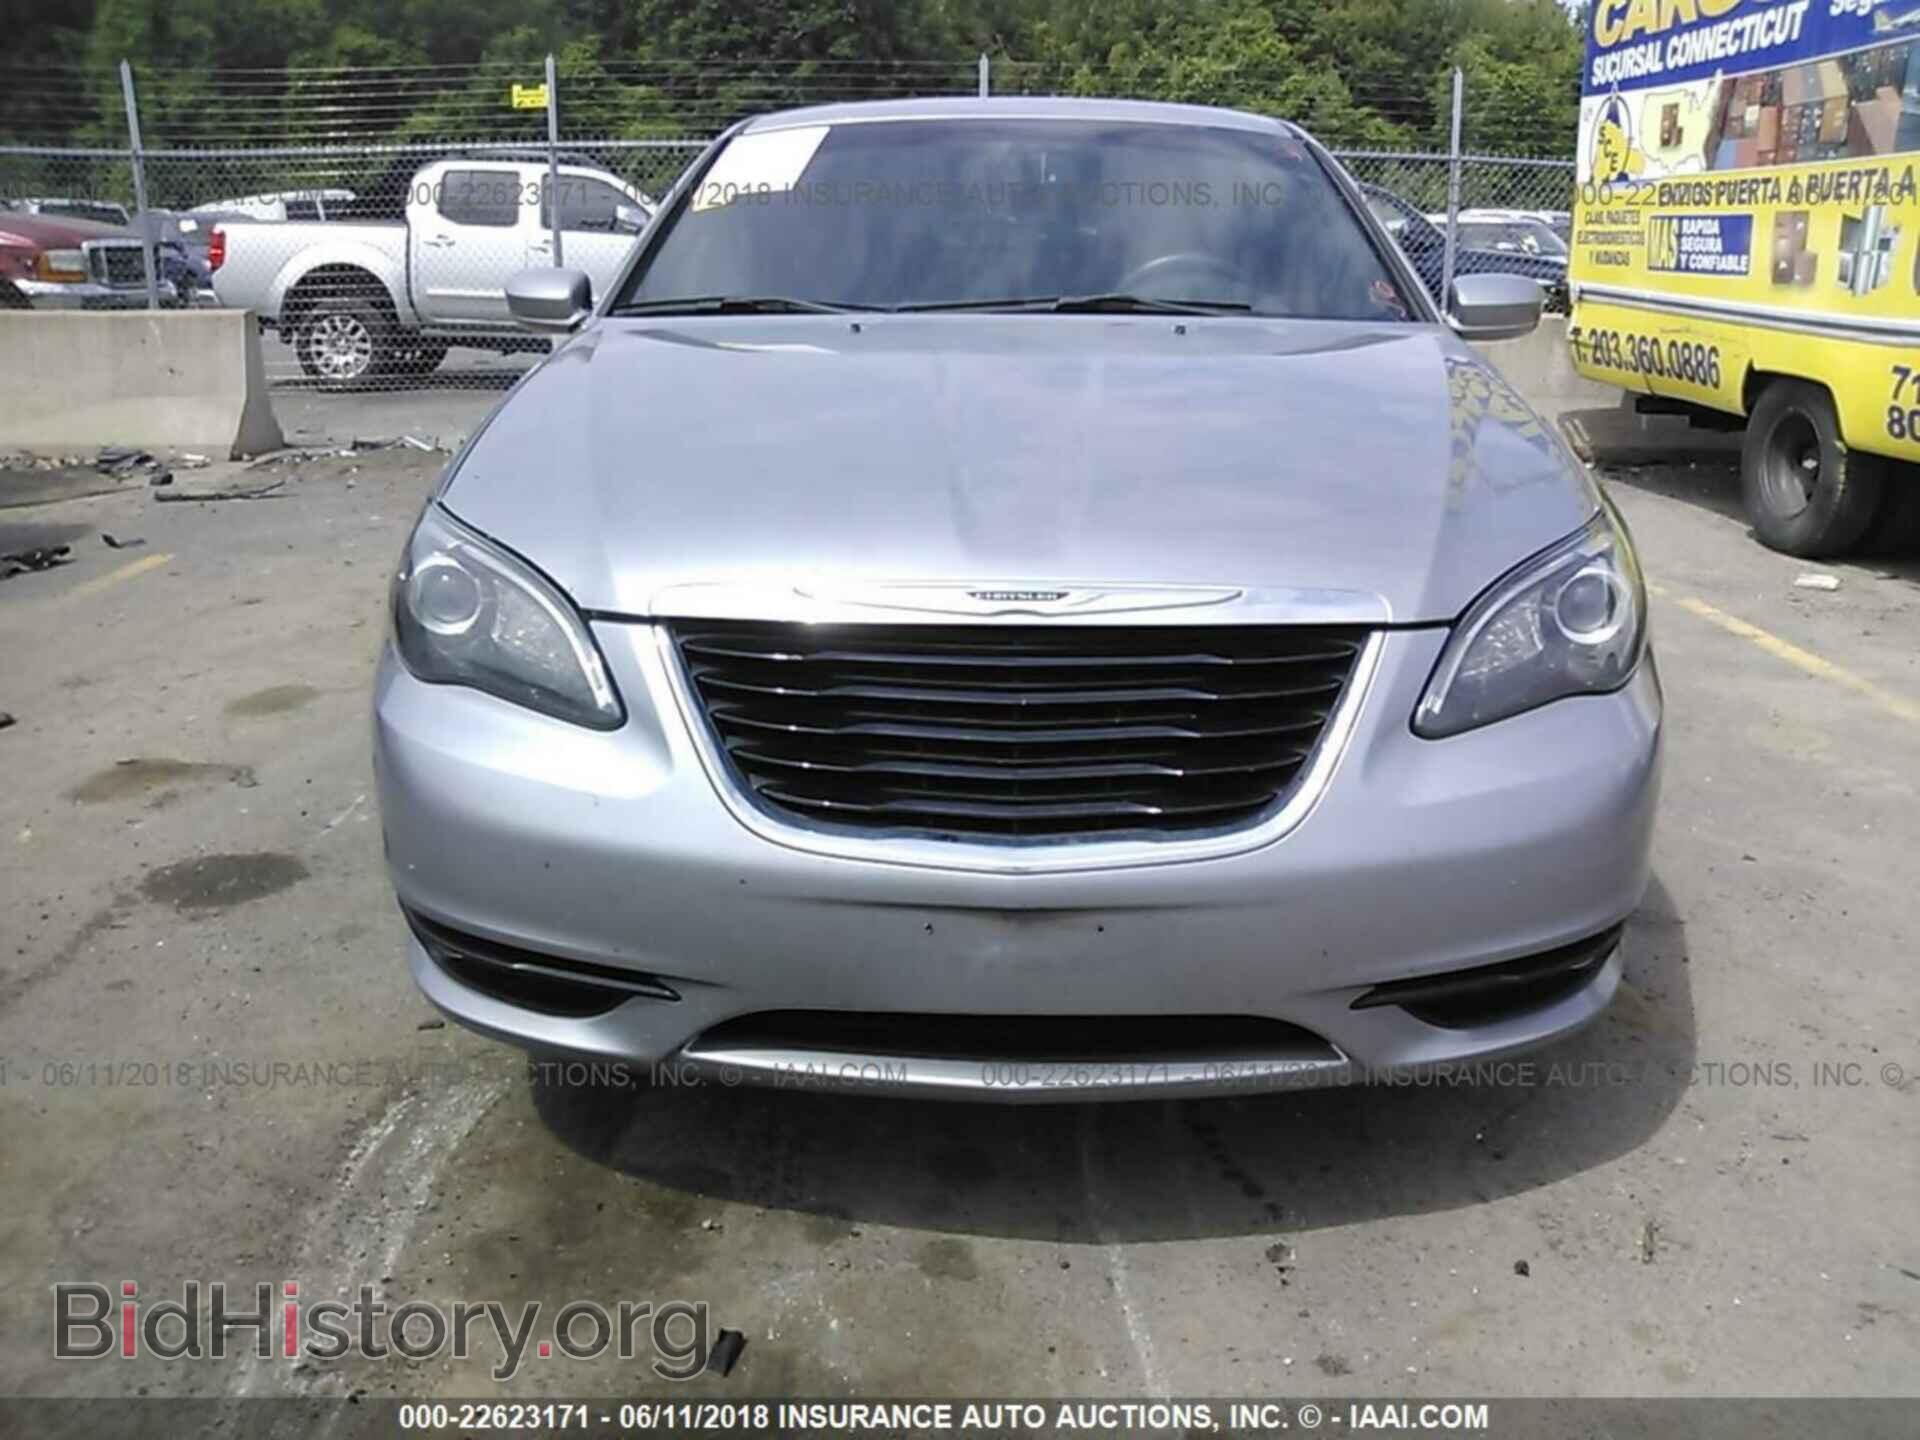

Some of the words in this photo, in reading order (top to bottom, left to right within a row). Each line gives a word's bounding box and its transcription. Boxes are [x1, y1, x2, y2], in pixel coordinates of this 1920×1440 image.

[1592, 40, 1664, 86] SUCURSAL
[1666, 1, 1809, 70] CONNECTICUT
[1714, 176, 1782, 205] PUERTA
[1805, 167, 1889, 203] PUERTA
[1689, 254, 1749, 271] CONFIABLE
[1589, 328, 1720, 389] 203.360.0886
